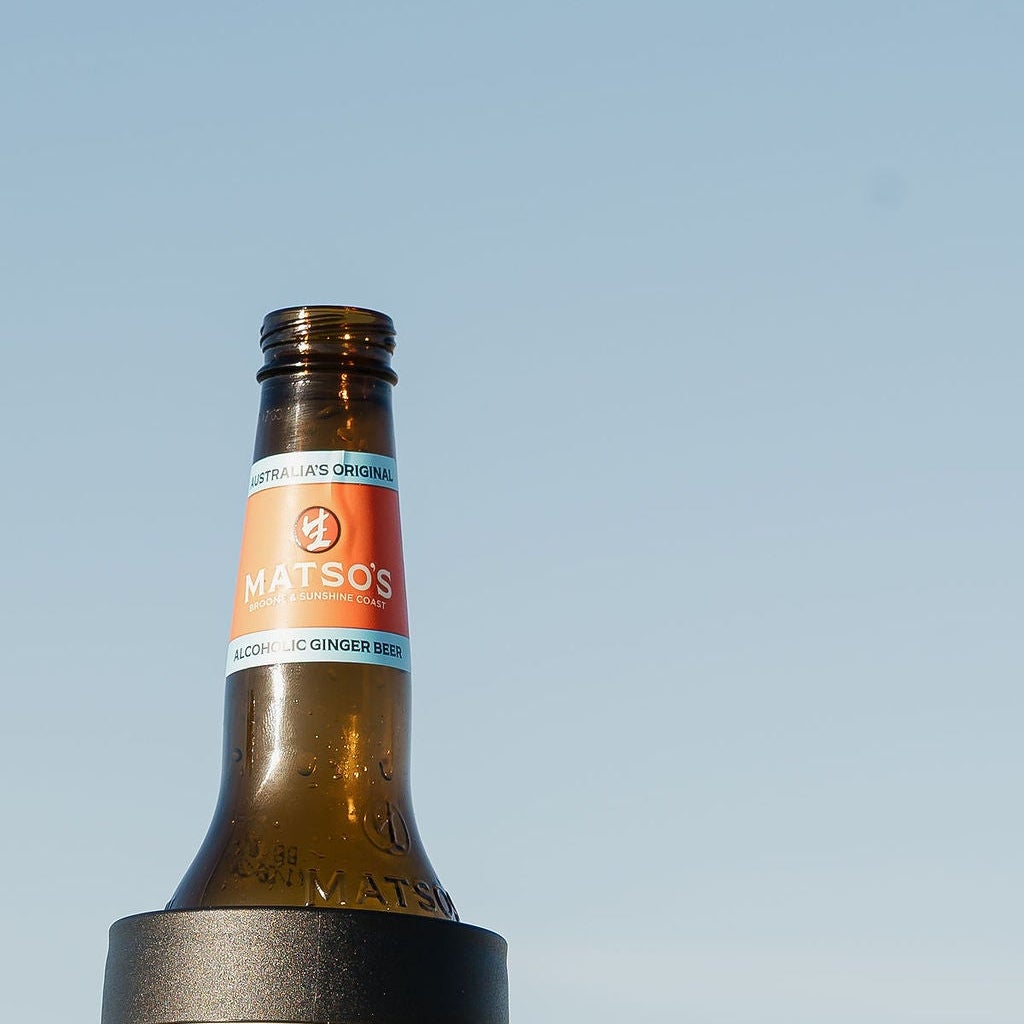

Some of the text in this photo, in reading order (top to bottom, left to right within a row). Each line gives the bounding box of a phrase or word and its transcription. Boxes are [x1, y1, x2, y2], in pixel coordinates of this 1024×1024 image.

[332, 463, 394, 482] ORIGINAL
[244, 561, 393, 603] MATSO'S
[299, 591, 353, 602] SUNSHINE
[356, 595, 387, 610] COAST
[233, 638, 403, 662] ALCOHOLIC GINGER BEER
